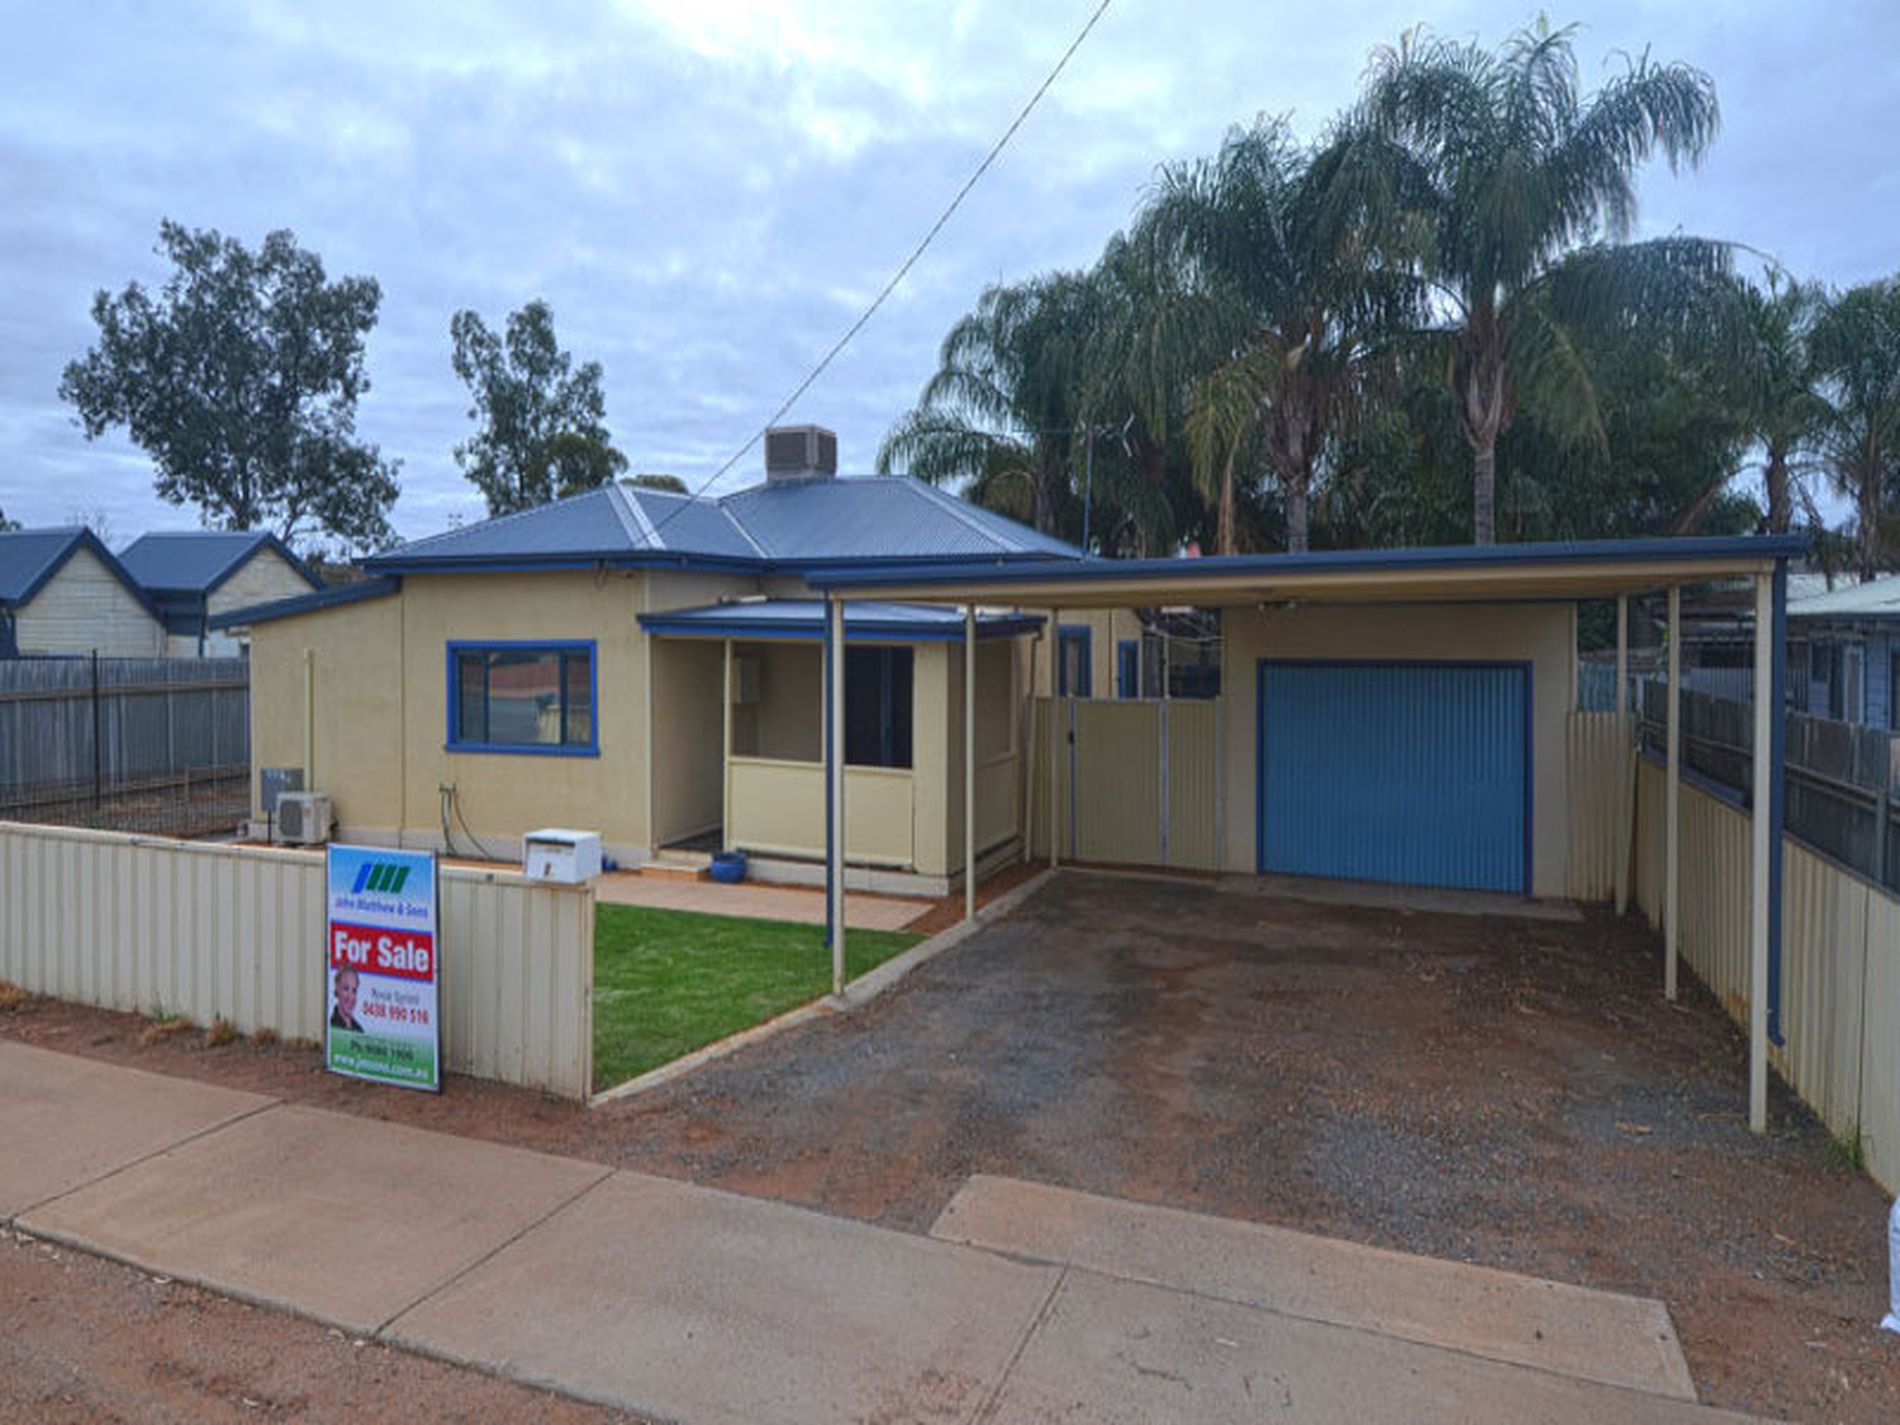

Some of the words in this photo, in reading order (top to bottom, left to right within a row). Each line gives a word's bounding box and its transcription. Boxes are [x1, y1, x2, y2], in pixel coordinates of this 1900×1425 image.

[398, 902, 405, 915] &
[334, 930, 371, 963] For
[377, 936, 429, 972] Sale
